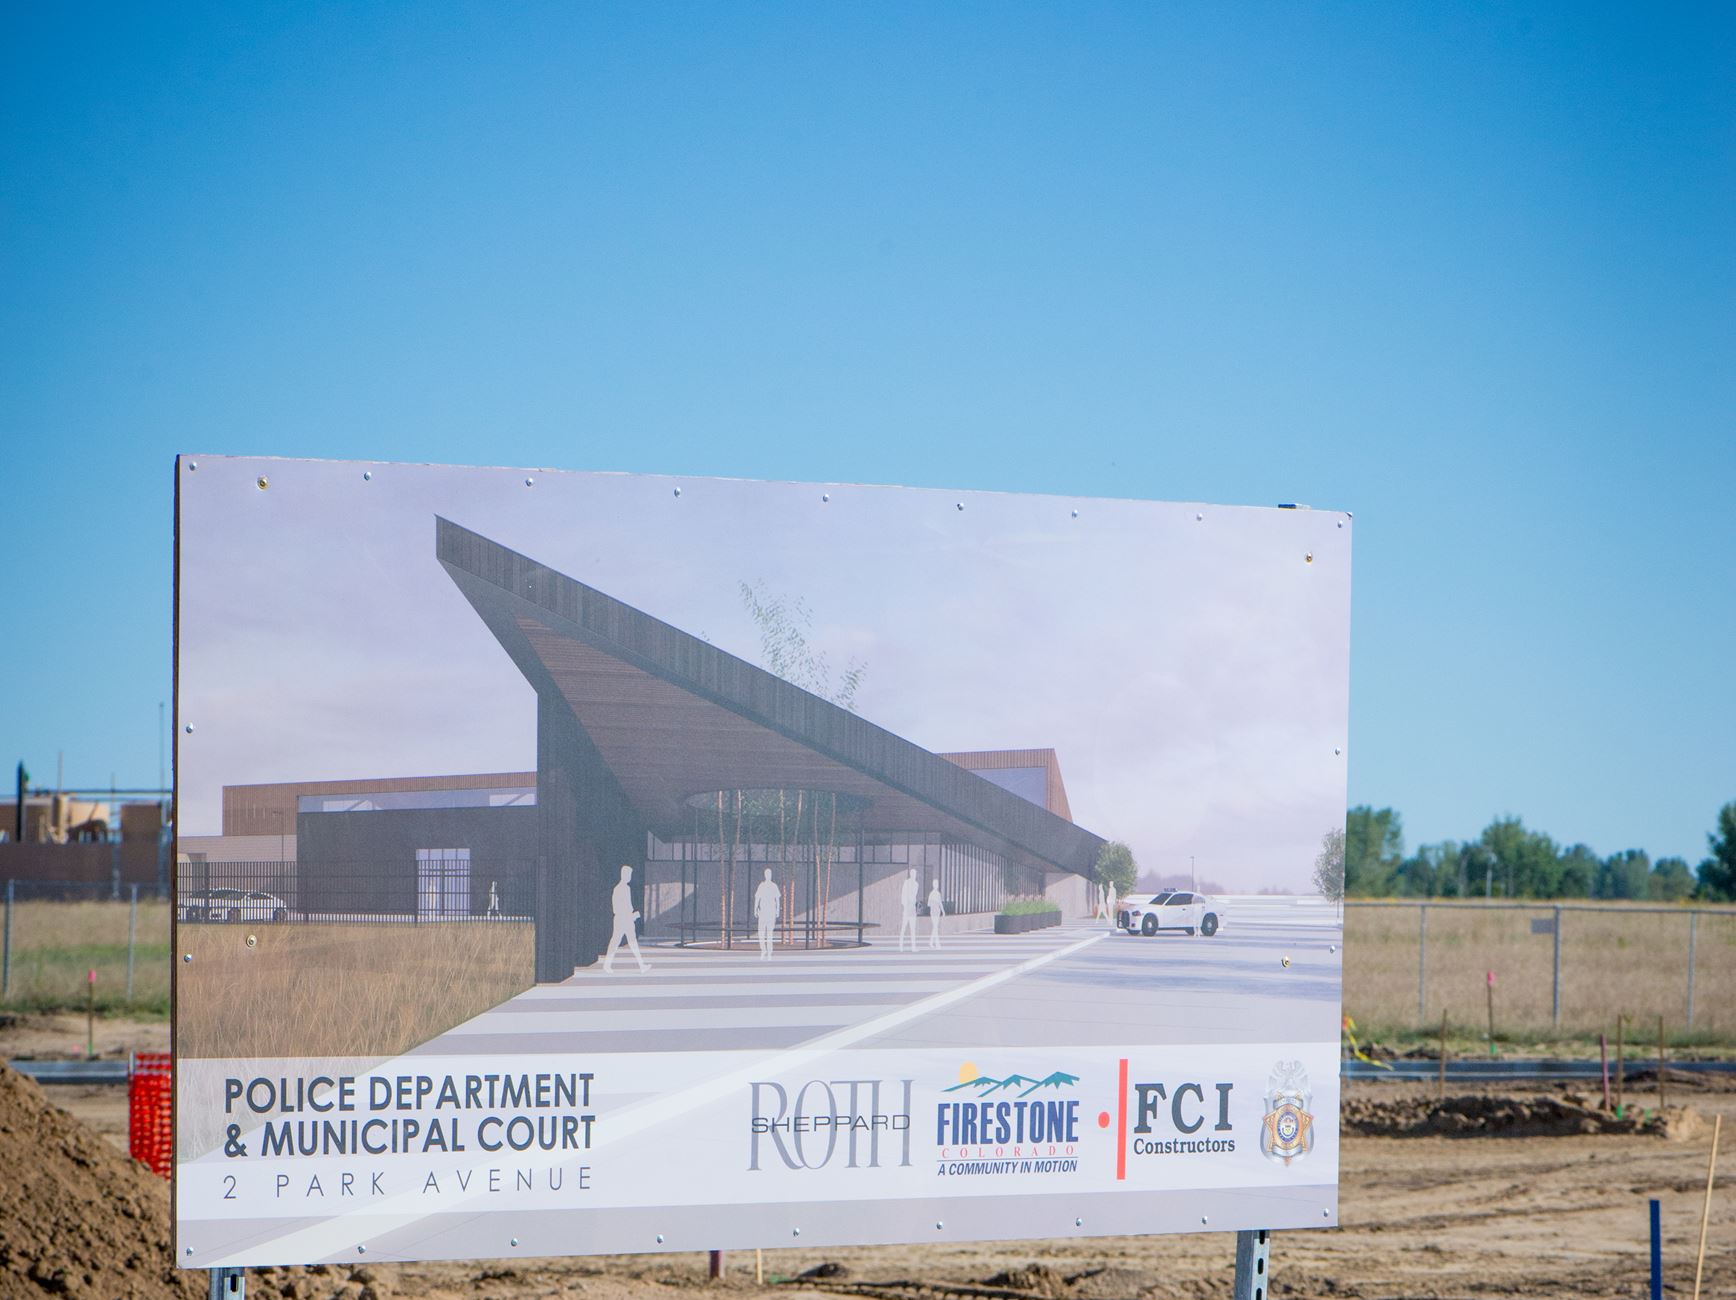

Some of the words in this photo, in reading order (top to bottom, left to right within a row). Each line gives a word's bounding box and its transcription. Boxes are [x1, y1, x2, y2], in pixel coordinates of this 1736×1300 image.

[225, 1076, 355, 1114] POLICE
[369, 1073, 595, 1111] DEPARTMENT
[1133, 1082, 1234, 1134] FCI
[224, 1123, 248, 1158] &
[261, 1117, 466, 1158] MUNICIPAL
[477, 1115, 596, 1152] COURT
[746, 1079, 916, 1172] ROTH
[751, 1113, 911, 1134] SHEPPARD
[936, 1100, 1080, 1146] FIRESTONE
[941, 1145, 1075, 1159] COLORADO
[1133, 1137, 1236, 1155] Constructors
[223, 1174, 237, 1199] 2
[276, 1171, 385, 1198] PARK
[422, 1166, 592, 1194] AVENUE
[937, 1163, 948, 1176] A
[949, 1161, 1018, 1176] COMMUNITY
[1019, 1161, 1032, 1174] IN
[1034, 1159, 1078, 1174] MOTION
